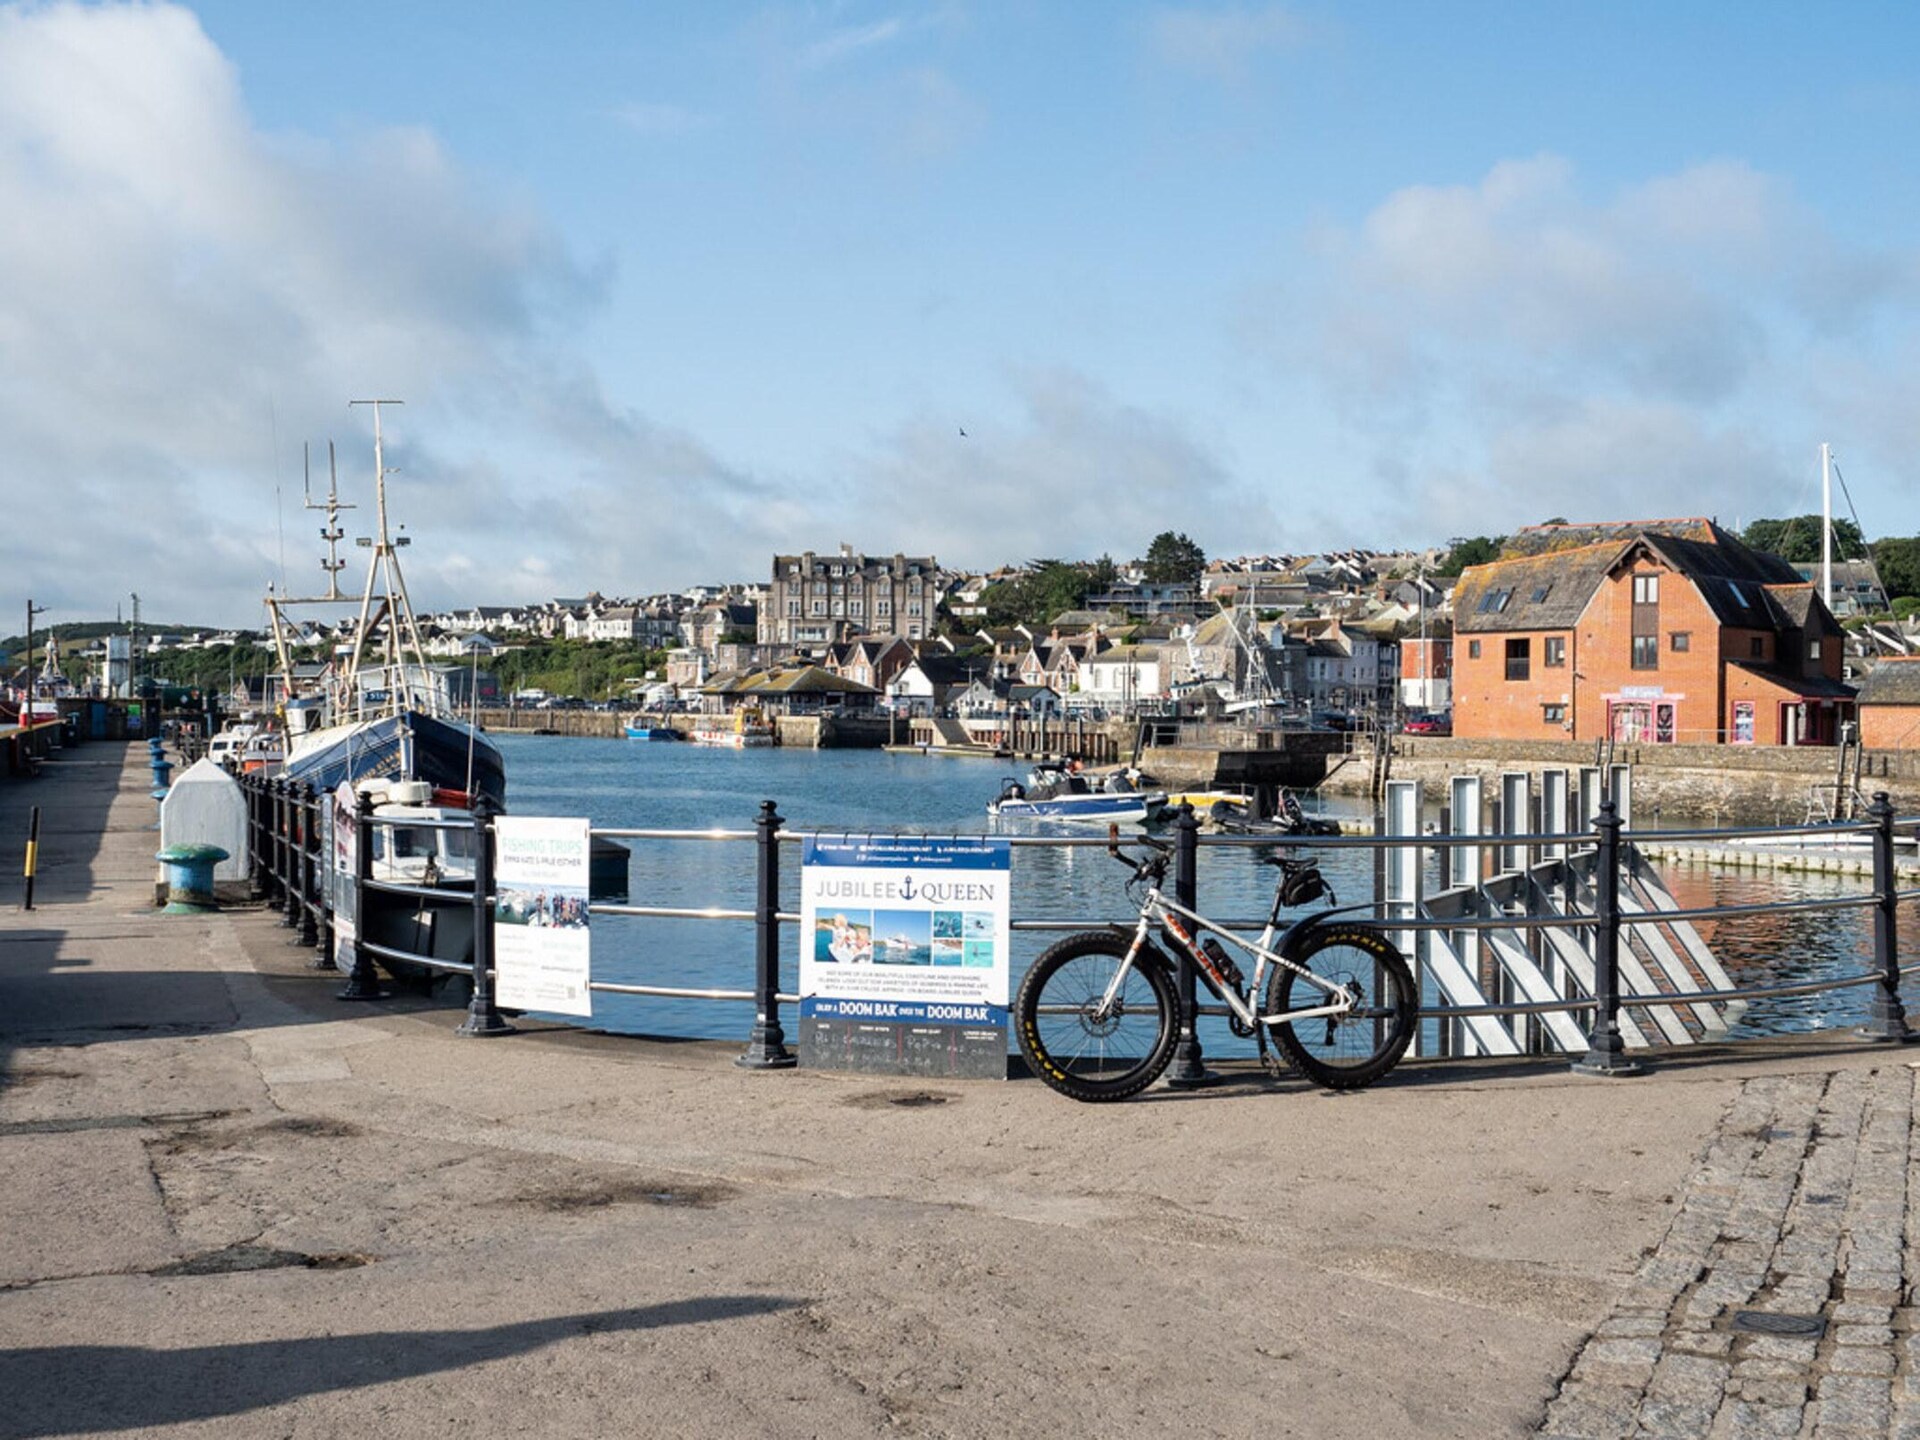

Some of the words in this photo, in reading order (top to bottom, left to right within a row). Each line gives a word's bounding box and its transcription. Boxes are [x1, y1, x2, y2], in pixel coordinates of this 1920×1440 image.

[502, 837, 545, 854] FISHING
[550, 839, 582, 856] TRIPS
[815, 881, 896, 898] JUBILEE
[921, 882, 995, 904] QUEEN
[1324, 932, 1386, 953] MAXXIS
[839, 1001, 873, 1016] DOOM
[875, 1003, 899, 1017] BAR
[927, 1005, 963, 1019] DOOM
[964, 1007, 989, 1020] BAR
[1024, 1020, 1067, 1082] MAXXIS
